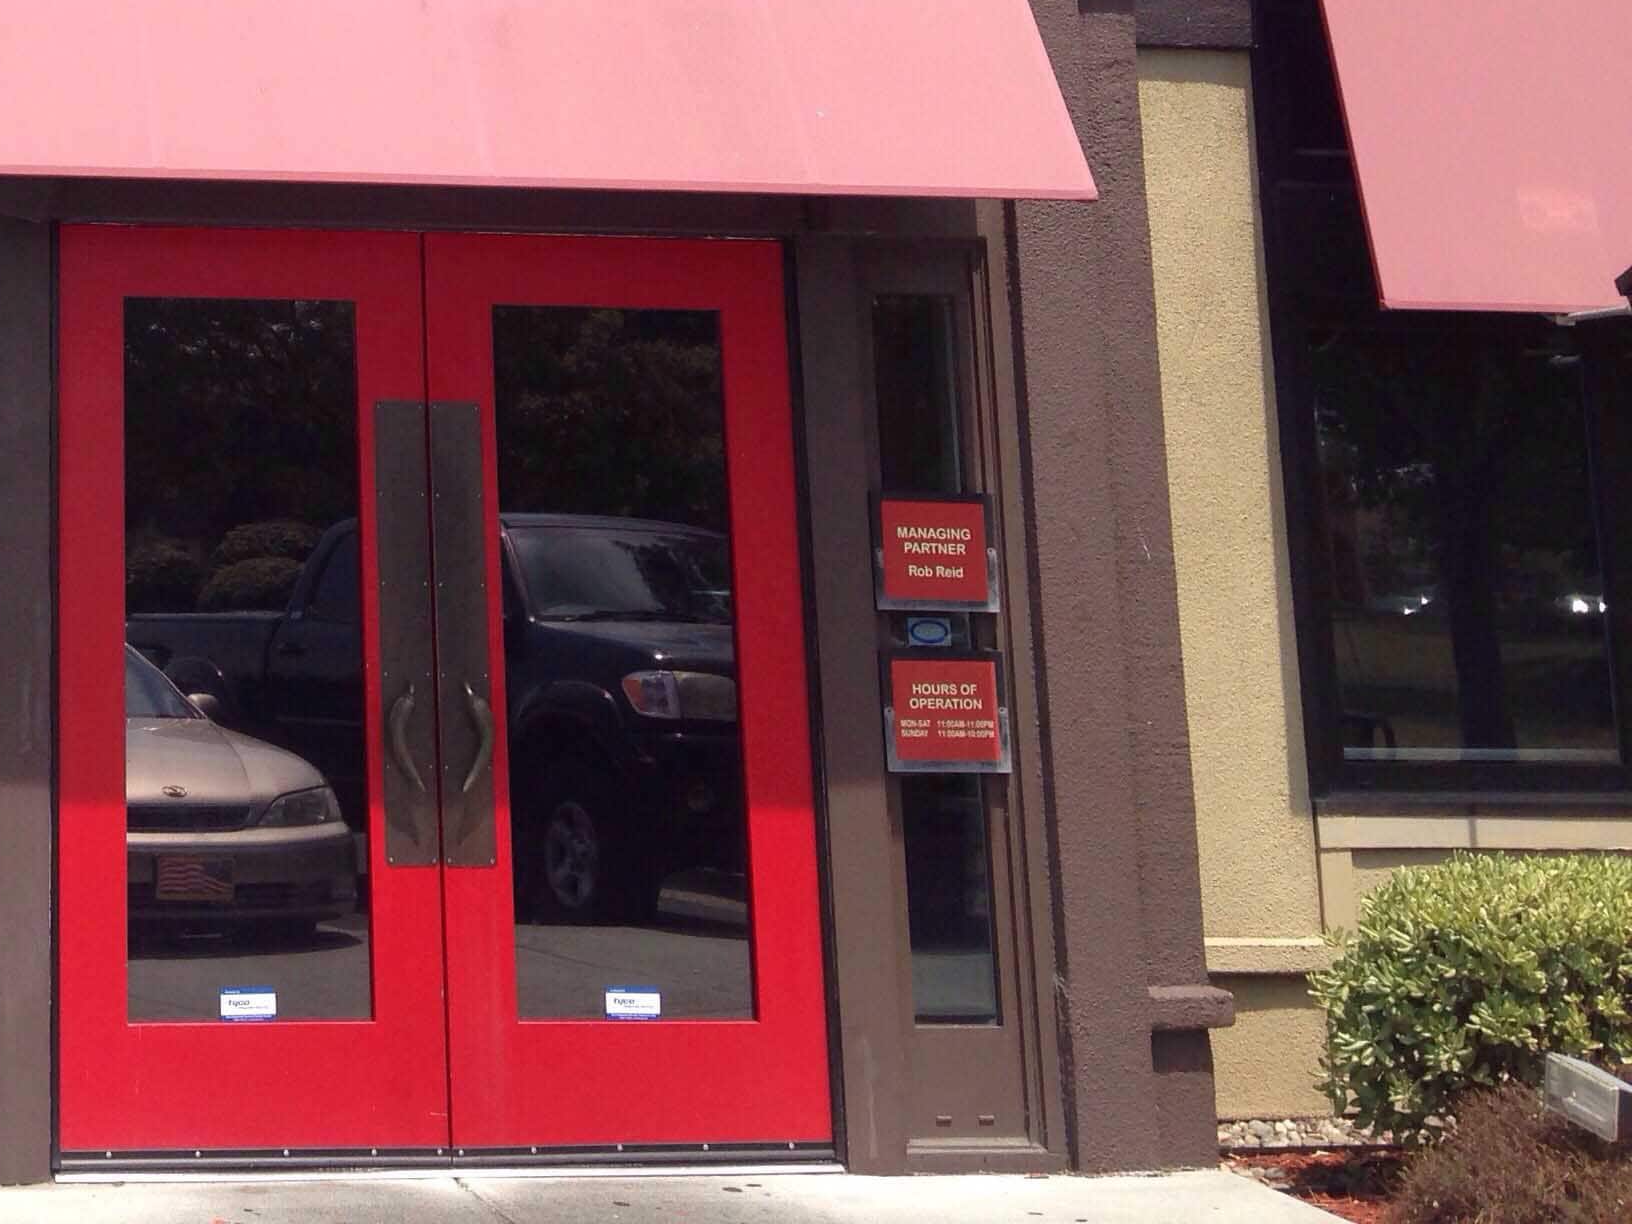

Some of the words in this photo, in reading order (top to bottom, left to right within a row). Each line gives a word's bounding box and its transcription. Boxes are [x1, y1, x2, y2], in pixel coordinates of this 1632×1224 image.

[897, 527, 971, 540] MANAGING
[904, 542, 966, 555] PARTNER
[908, 565, 933, 577] Rob
[936, 566, 963, 578] Reid
[912, 684, 957, 695] HOURS
[960, 684, 977, 695] OF
[909, 698, 982, 710] OPERATION
